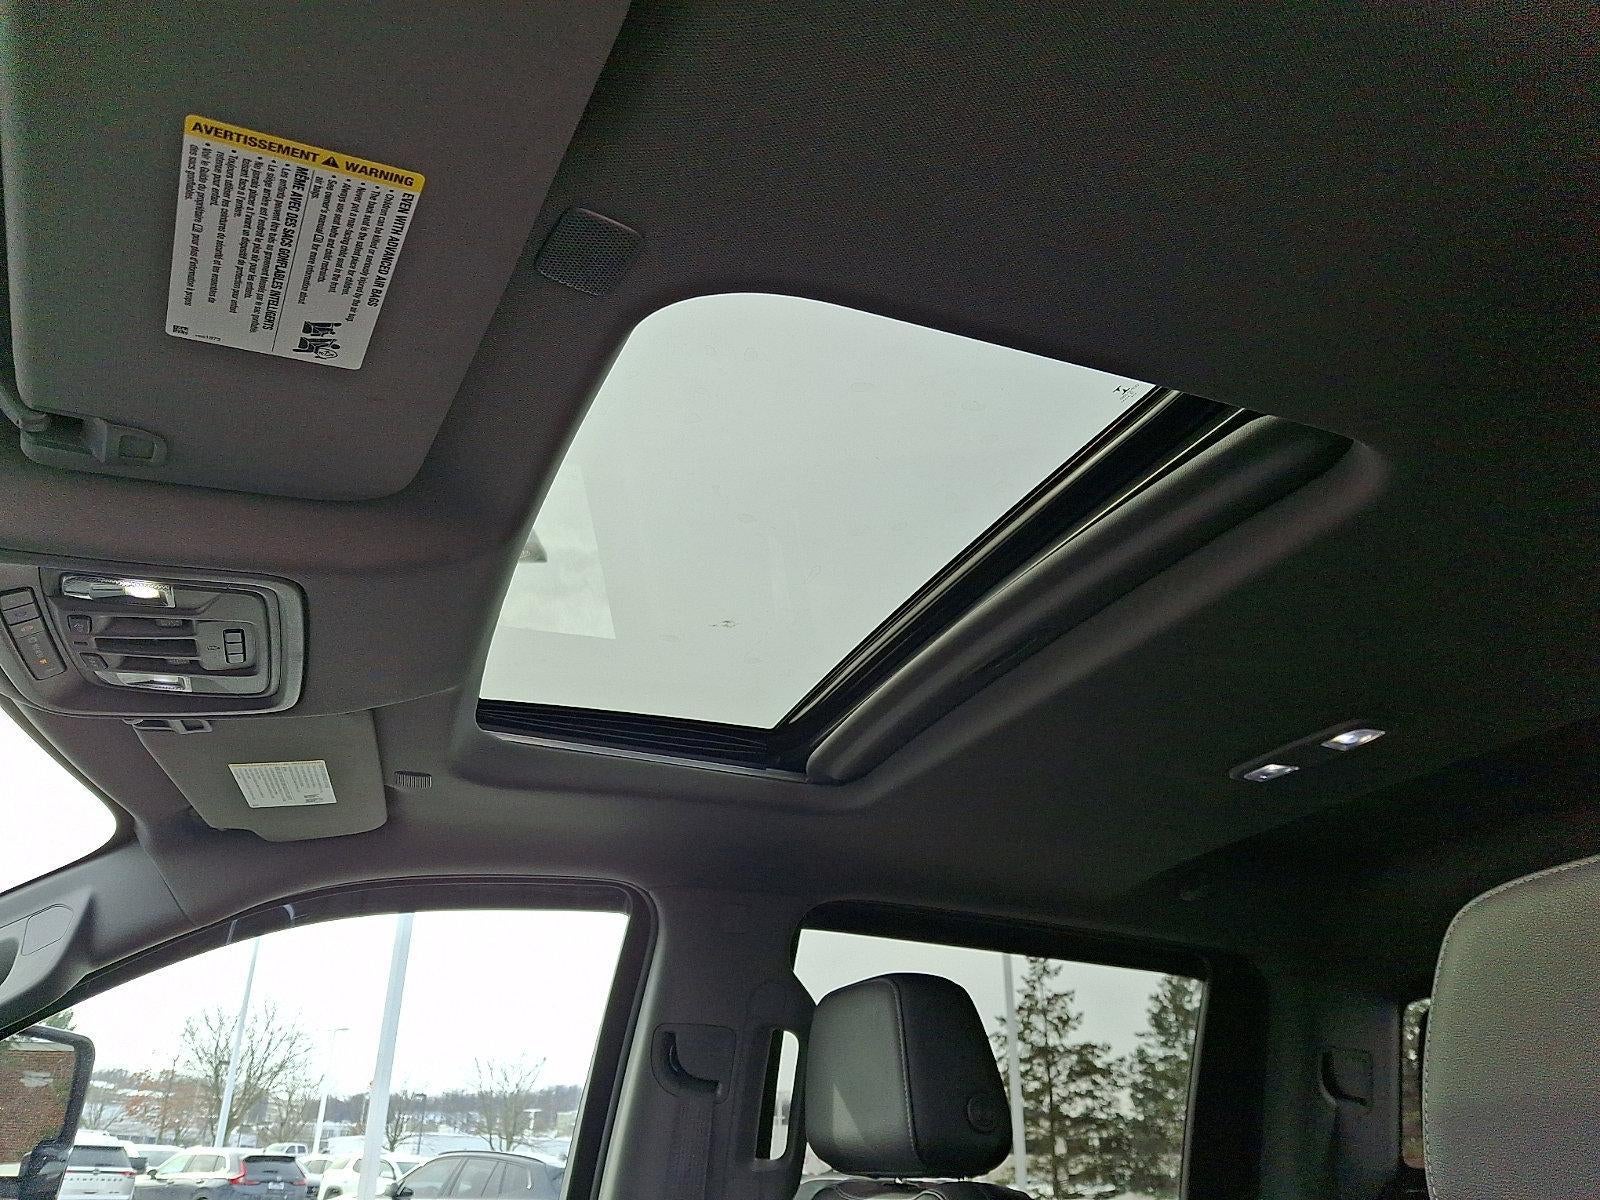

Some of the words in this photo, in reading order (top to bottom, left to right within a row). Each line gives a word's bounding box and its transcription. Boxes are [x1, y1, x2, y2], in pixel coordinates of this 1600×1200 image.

[191, 121, 320, 163] AVERTISSEMENT
[344, 160, 415, 188] WARNING
[292, 165, 311, 192] MÊME
[287, 190, 304, 213] AVEC
[397, 192, 414, 215] EVEN
[284, 211, 299, 228] DES
[390, 215, 407, 236] WITH
[279, 227, 296, 248] SACS
[377, 235, 400, 276] ADVANCED
[270, 247, 291, 292] GONFLABLES
[372, 274, 387, 289] AIR
[367, 288, 383, 308] BAGS
[261, 289, 286, 333] INTELLIGENTS
